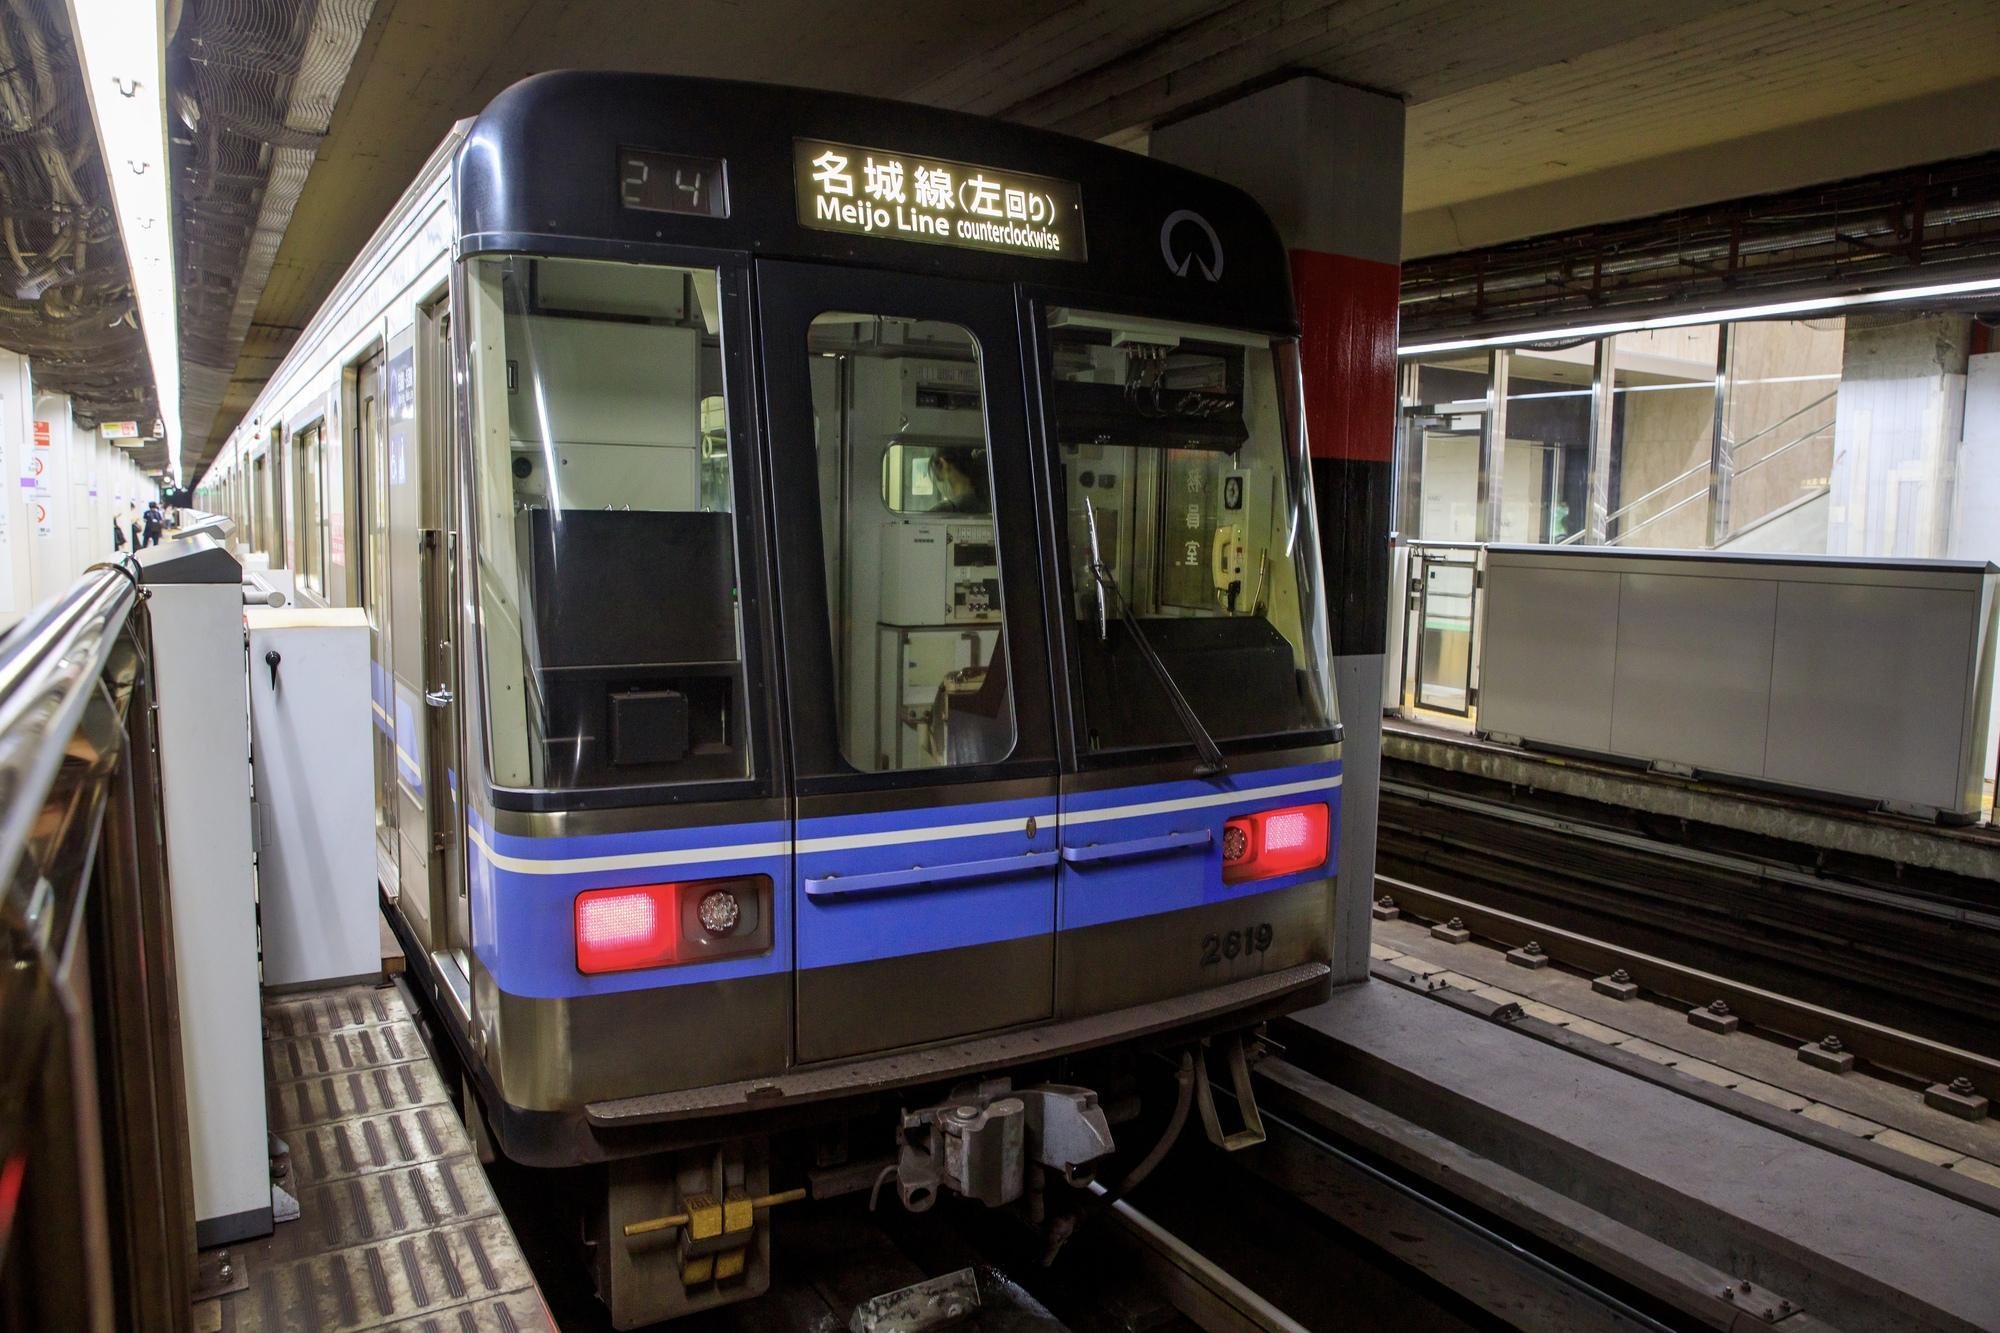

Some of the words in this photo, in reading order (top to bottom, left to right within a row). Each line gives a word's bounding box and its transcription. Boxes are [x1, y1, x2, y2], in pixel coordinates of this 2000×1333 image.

[816, 195, 890, 232] Meijo
[896, 206, 950, 236] Line
[957, 219, 1060, 251] counterclockwise
[1201, 922, 1273, 966] 2619
